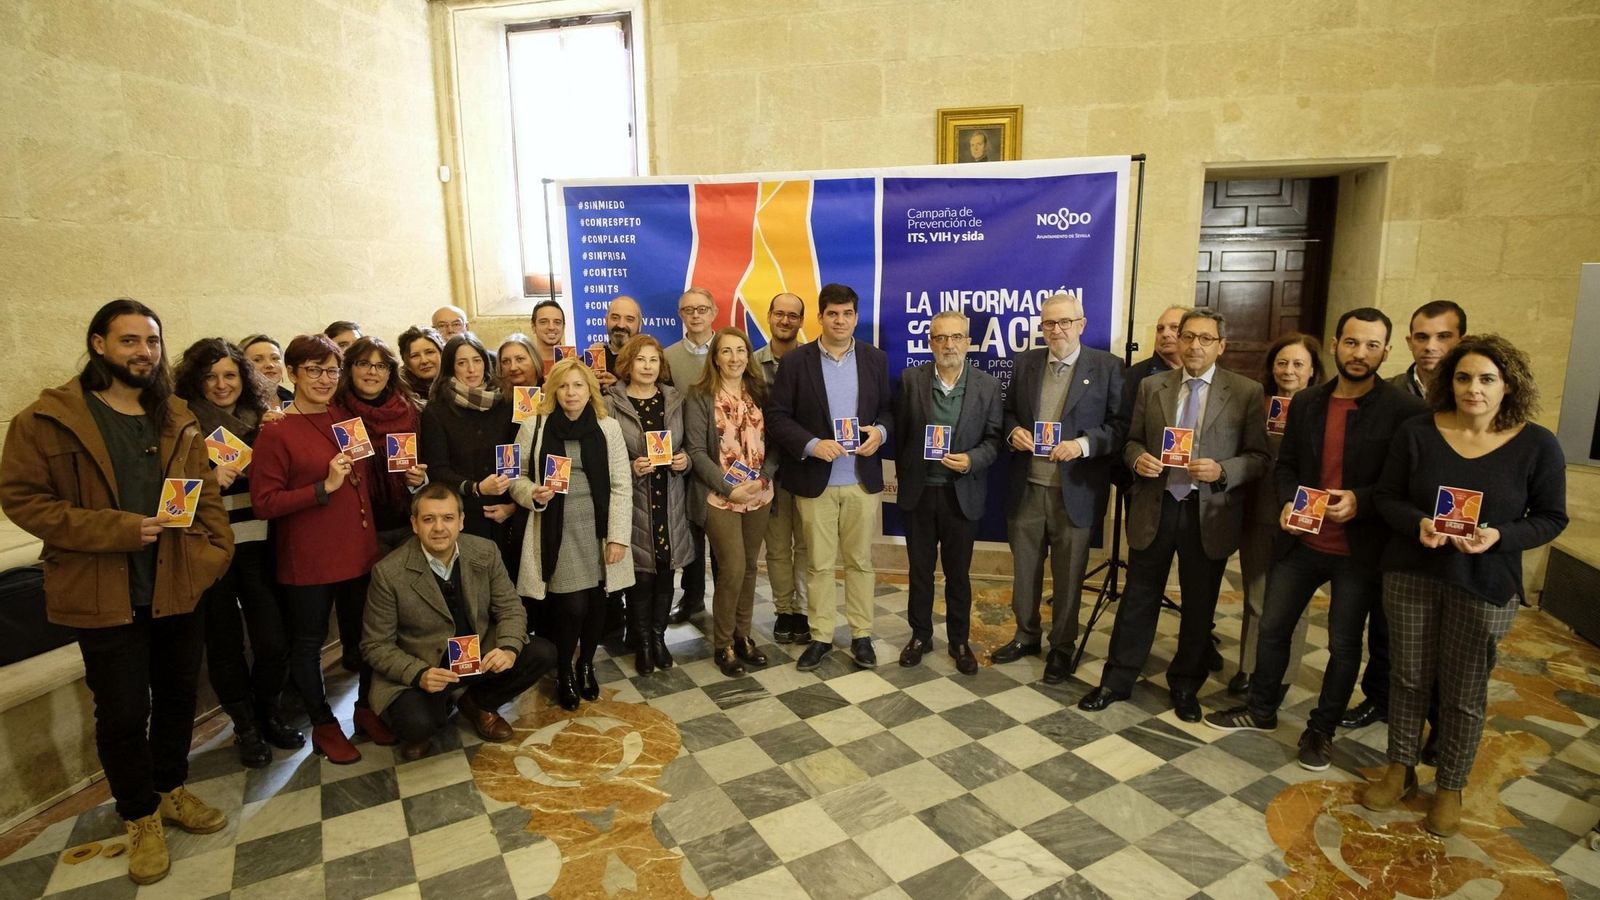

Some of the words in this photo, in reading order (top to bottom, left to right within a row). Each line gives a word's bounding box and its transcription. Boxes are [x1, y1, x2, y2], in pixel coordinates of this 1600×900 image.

[578, 200, 625, 210] #SINMIEDO
[907, 207, 957, 219] Campaña
[959, 206, 973, 217] de
[580, 217, 641, 227] #CONRESPETO
[908, 217, 967, 229] Prevención
[968, 217, 982, 227] de
[582, 234, 636, 244] #CONPLACER
[907, 232, 928, 244] ITS,
[929, 231, 951, 241] VIH
[953, 233, 960, 243] y
[961, 231, 984, 241] sida
[582, 251, 626, 261] #SINPRISA
[583, 268, 627, 278] #CONTEST
[584, 284, 619, 294] #SINITS
[906, 292, 932, 316] LA
